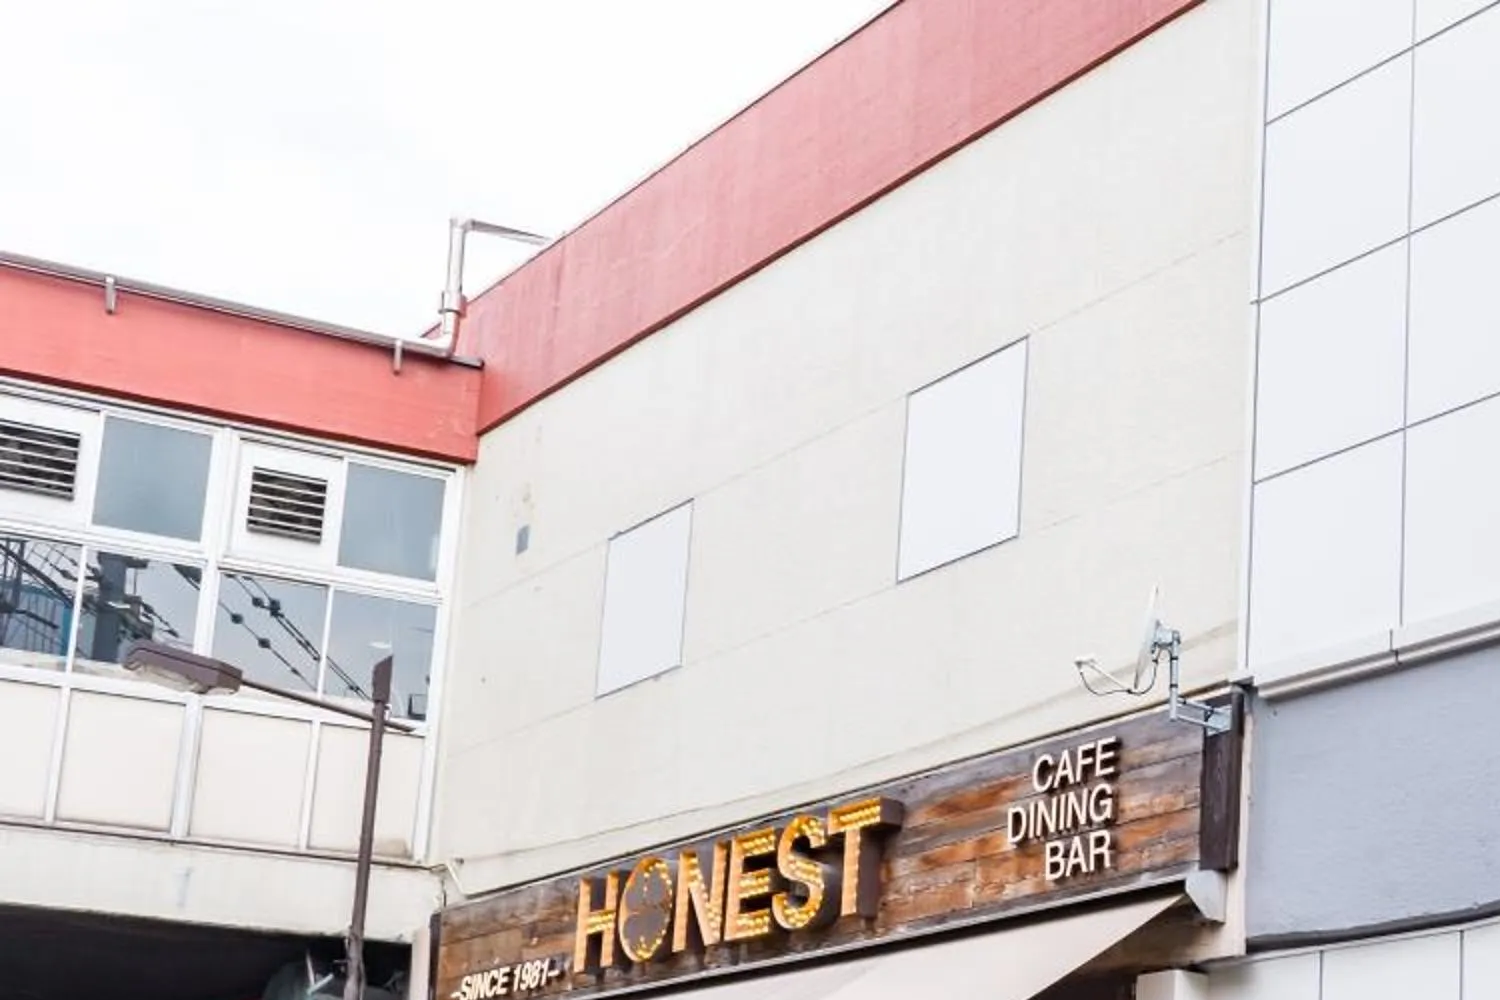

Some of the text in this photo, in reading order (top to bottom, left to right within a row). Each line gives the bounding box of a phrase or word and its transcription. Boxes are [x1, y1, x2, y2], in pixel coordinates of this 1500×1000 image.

[1032, 735, 1118, 792] CAFE
[1007, 783, 1114, 845] DINING
[1045, 829, 1112, 881] BAR
[573, 803, 890, 974] HONEST
